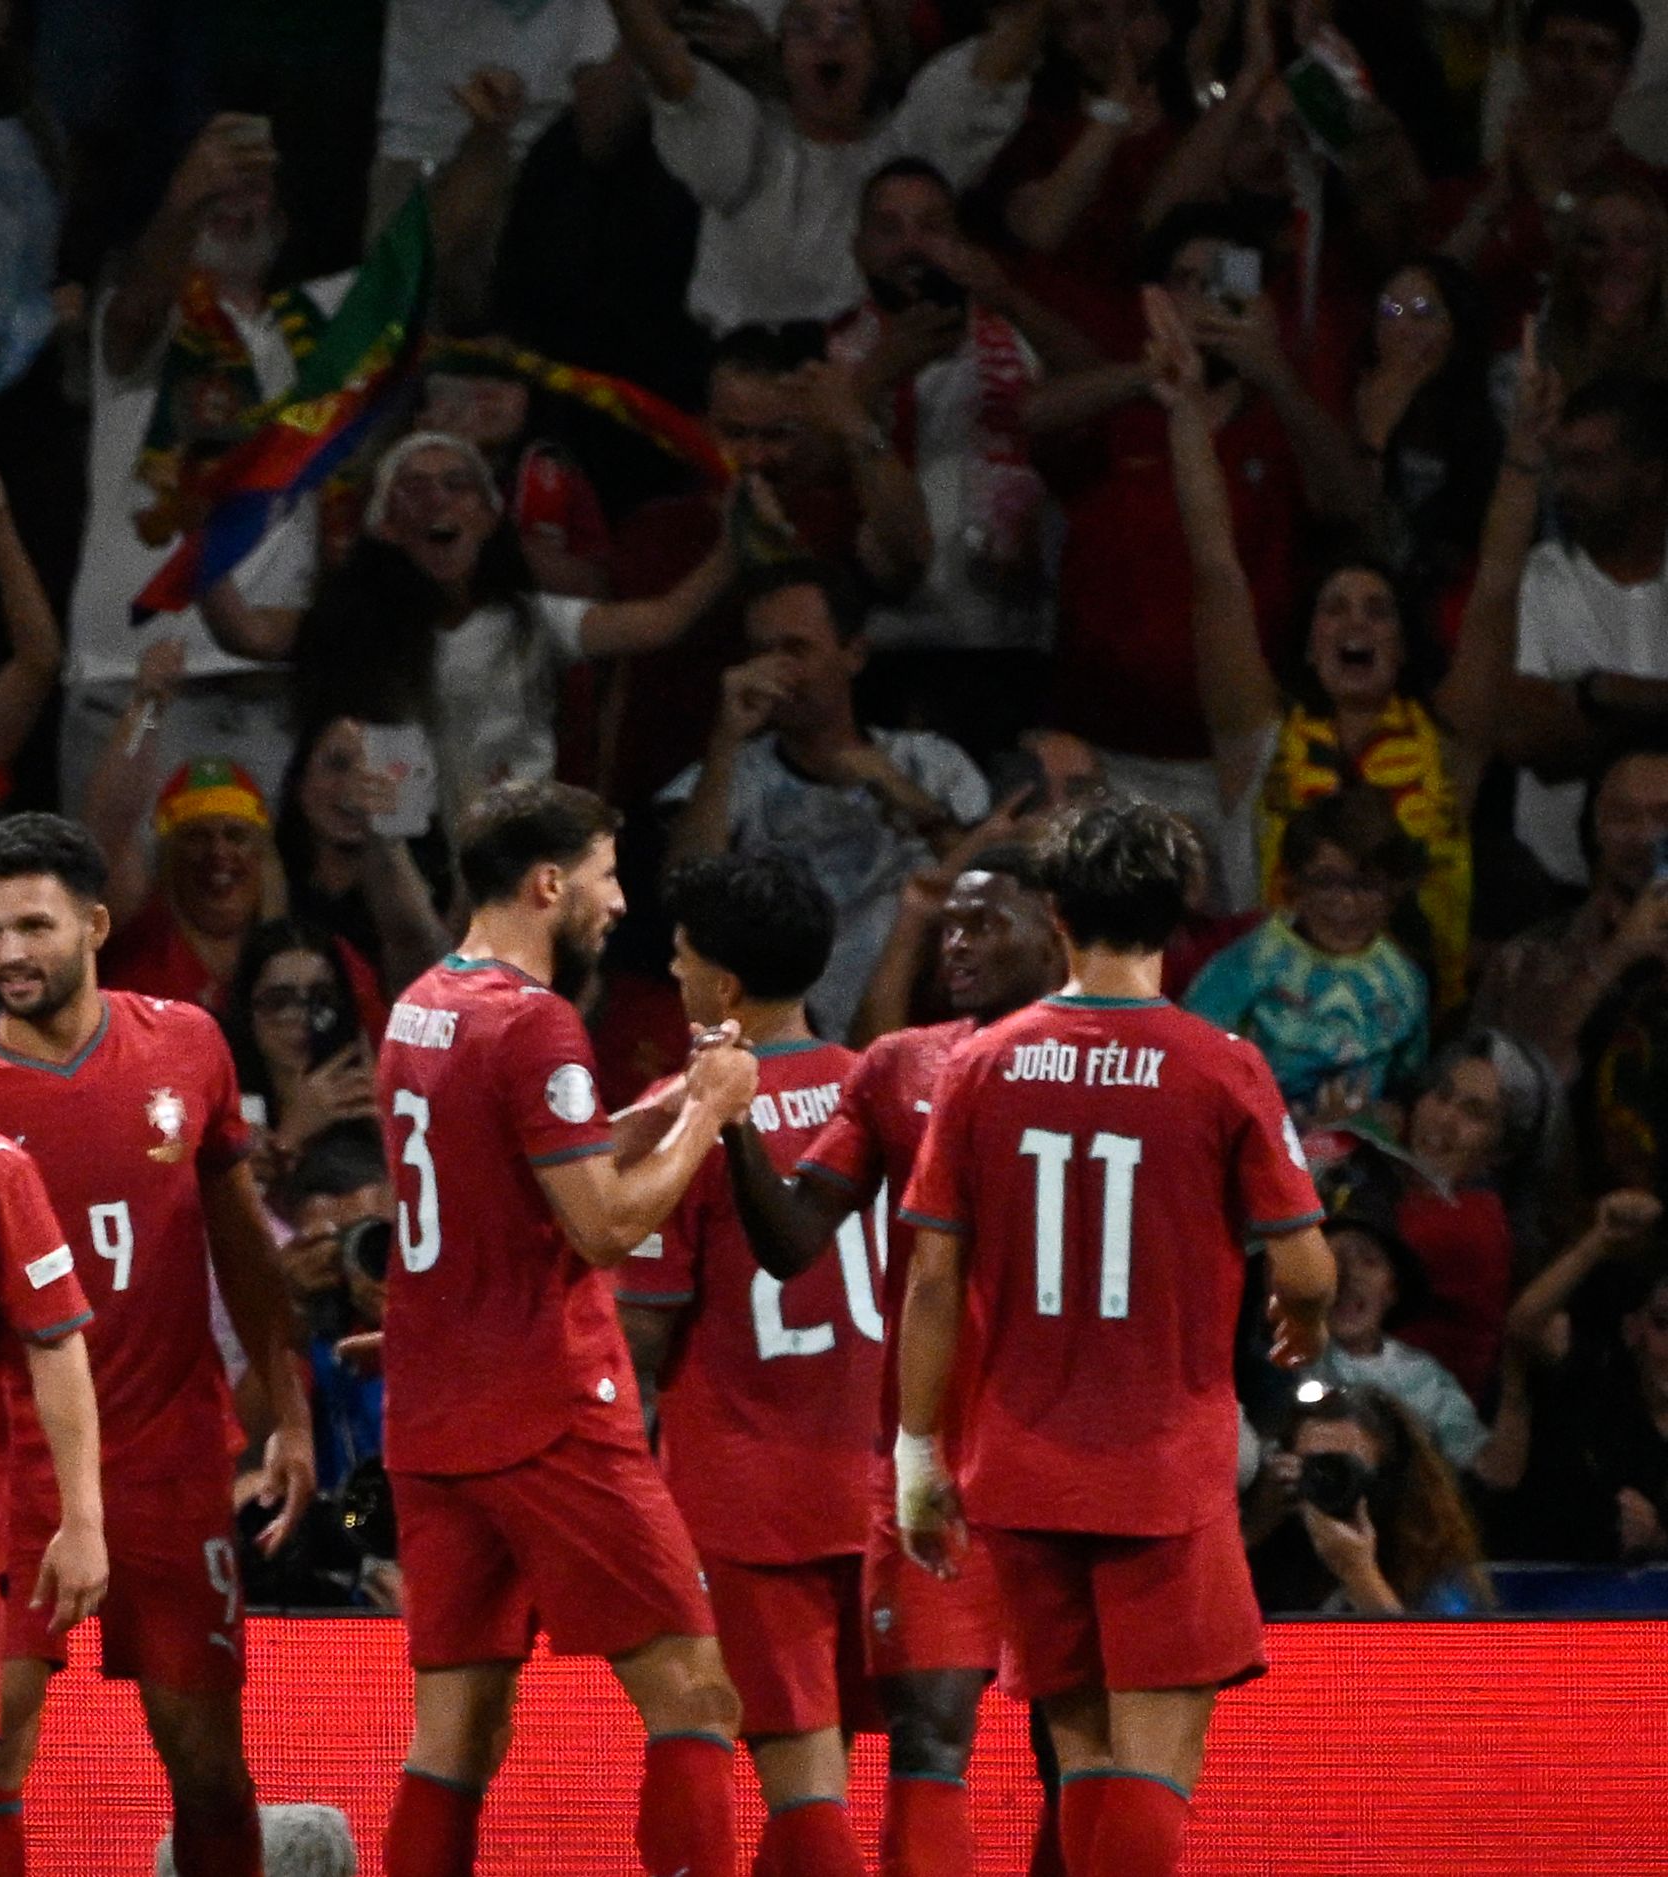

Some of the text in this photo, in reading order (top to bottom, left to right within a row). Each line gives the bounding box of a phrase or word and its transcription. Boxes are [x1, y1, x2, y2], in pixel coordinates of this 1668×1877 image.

[1003, 1037, 1166, 1088] JOÃO FÉLIX
[393, 1088, 441, 1273] 3
[1018, 1127, 1143, 1319] 11
[88, 1200, 134, 1291] 9
[204, 1539, 237, 1623] 9
